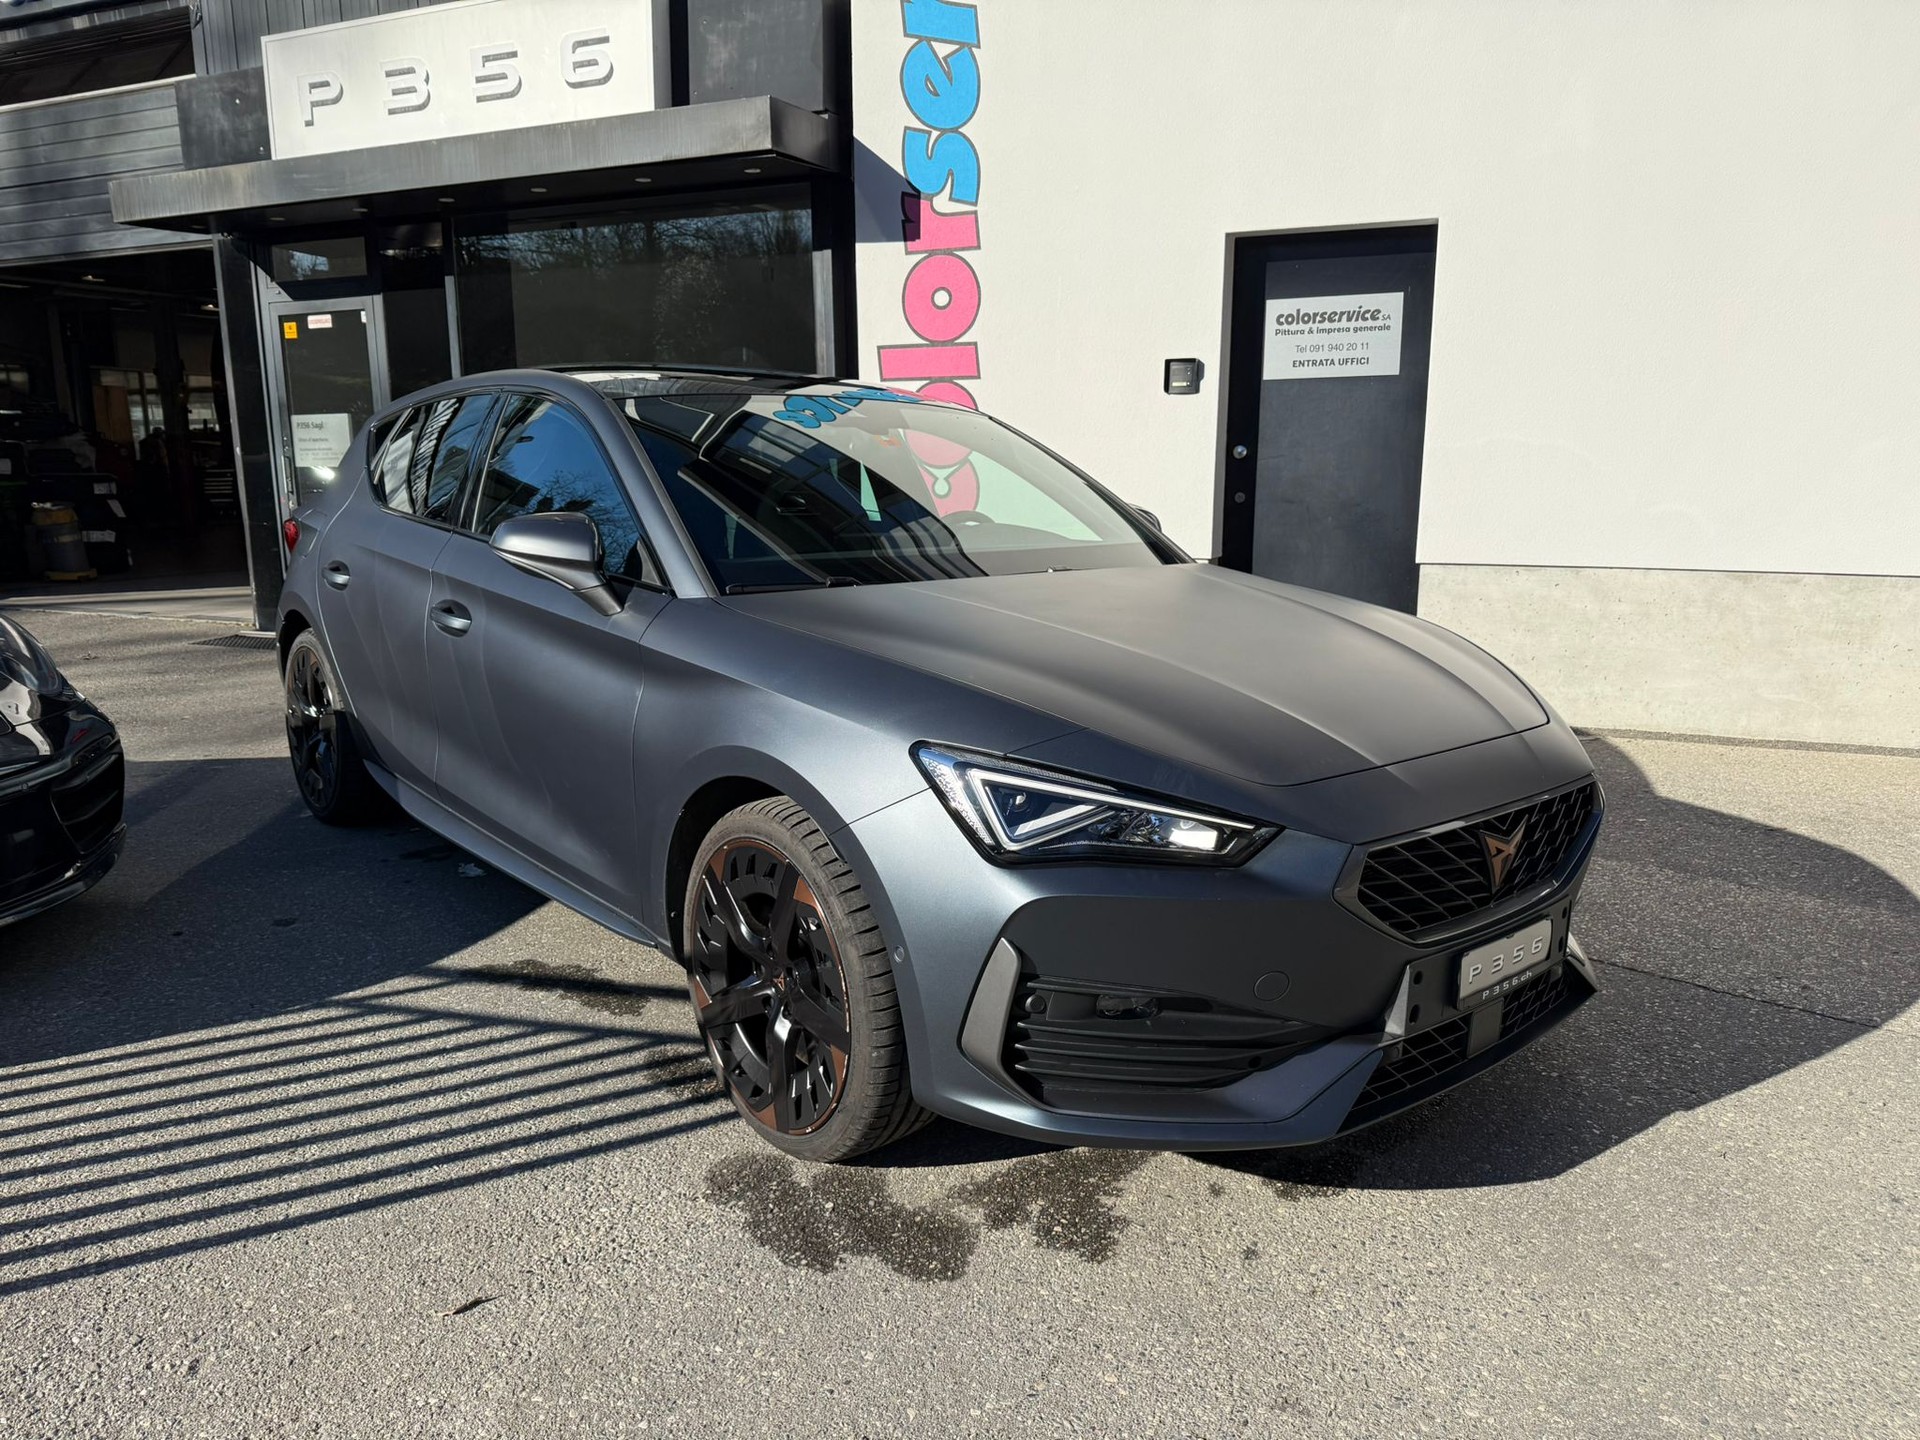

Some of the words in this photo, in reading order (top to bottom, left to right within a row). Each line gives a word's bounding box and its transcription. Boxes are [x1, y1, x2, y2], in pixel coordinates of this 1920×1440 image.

[1275, 305, 1382, 326] colorservice
[1381, 313, 1391, 322] SA
[1275, 328, 1305, 336] Pittura
[1307, 327, 1315, 335] &
[1353, 323, 1391, 333] generale
[1295, 344, 1308, 353] Tel
[1309, 343, 1324, 353] 091
[1327, 343, 1344, 352] 940
[1346, 342, 1358, 351] 20
[1361, 342, 1369, 350] 11
[1292, 358, 1336, 368] ENTRATA
[1338, 357, 1370, 366] UFFICI
